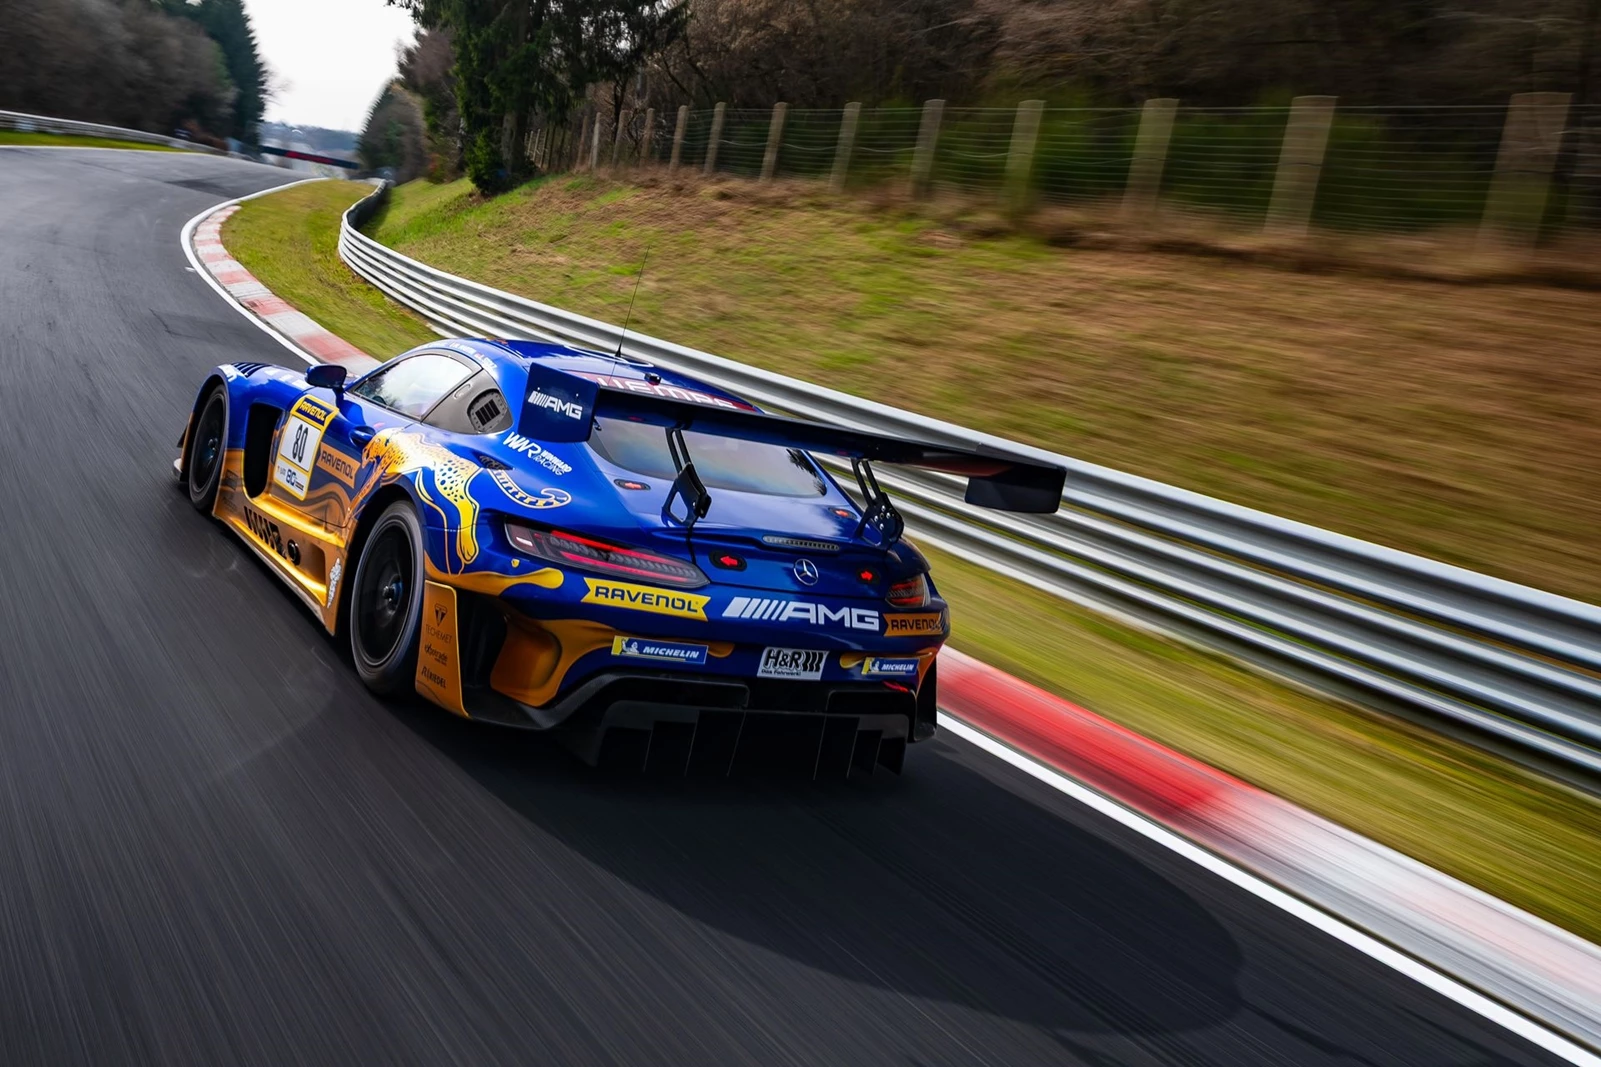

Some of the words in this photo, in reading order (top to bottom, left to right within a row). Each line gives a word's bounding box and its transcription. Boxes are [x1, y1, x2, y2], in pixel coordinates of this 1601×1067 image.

[300, 401, 327, 421] RAVENOL
[544, 395, 583, 420] AMG
[292, 423, 309, 463] 80
[321, 450, 354, 480] RAVENOL
[595, 585, 698, 613] RAVENOL
[779, 601, 879, 631] AMG
[642, 645, 700, 659] MICHELIN
[764, 649, 802, 669] H&R
[881, 663, 915, 671] MICHELIN
